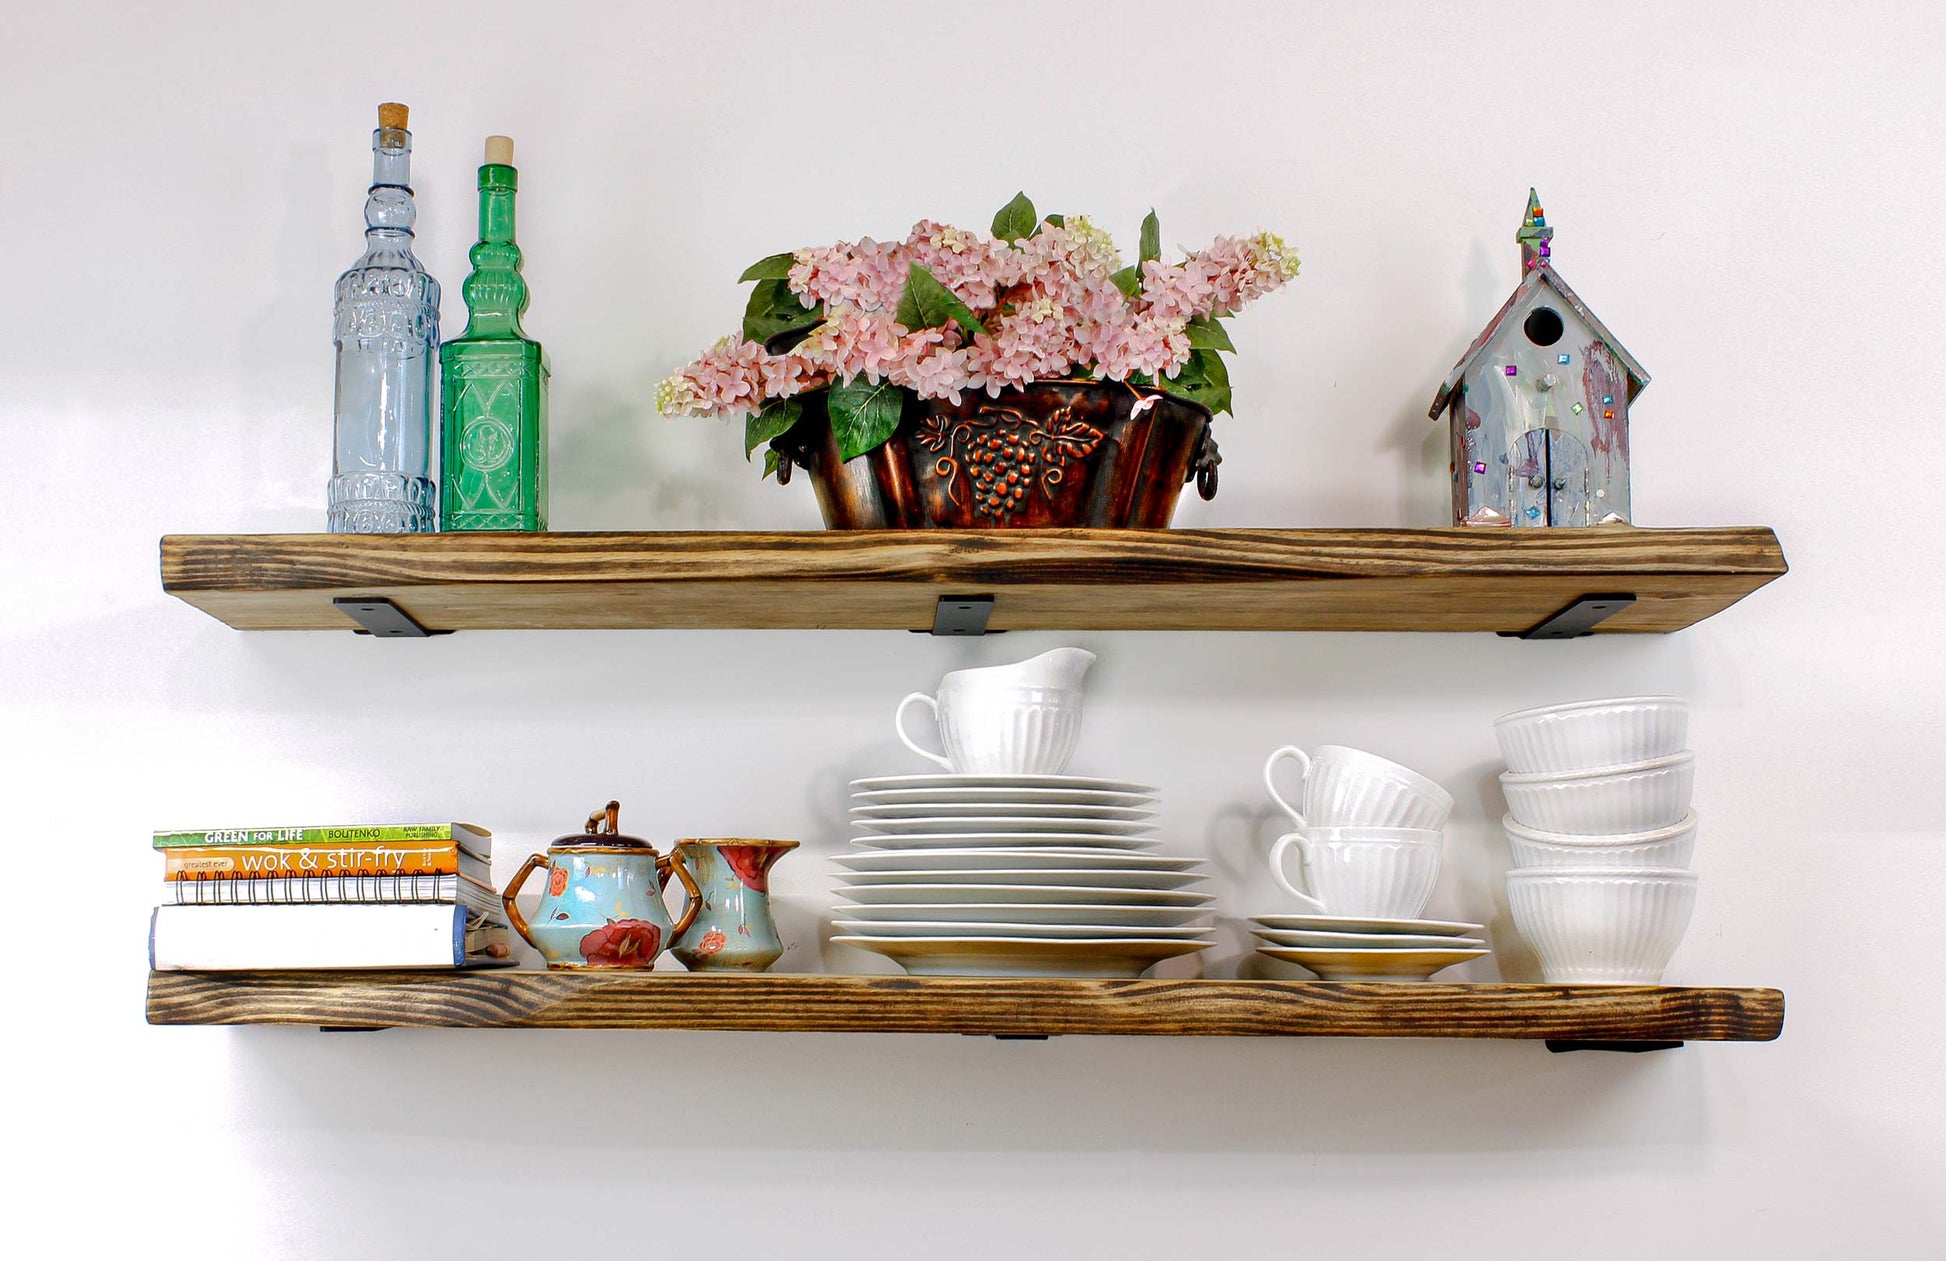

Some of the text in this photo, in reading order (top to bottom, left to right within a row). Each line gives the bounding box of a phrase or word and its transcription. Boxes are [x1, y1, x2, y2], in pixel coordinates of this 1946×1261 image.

[205, 829, 303, 843] GREEN FOR LIFE
[328, 829, 381, 839] BOUTENKO
[241, 851, 292, 871] wok
[298, 848, 319, 870] &
[327, 846, 406, 874] stir-fry
